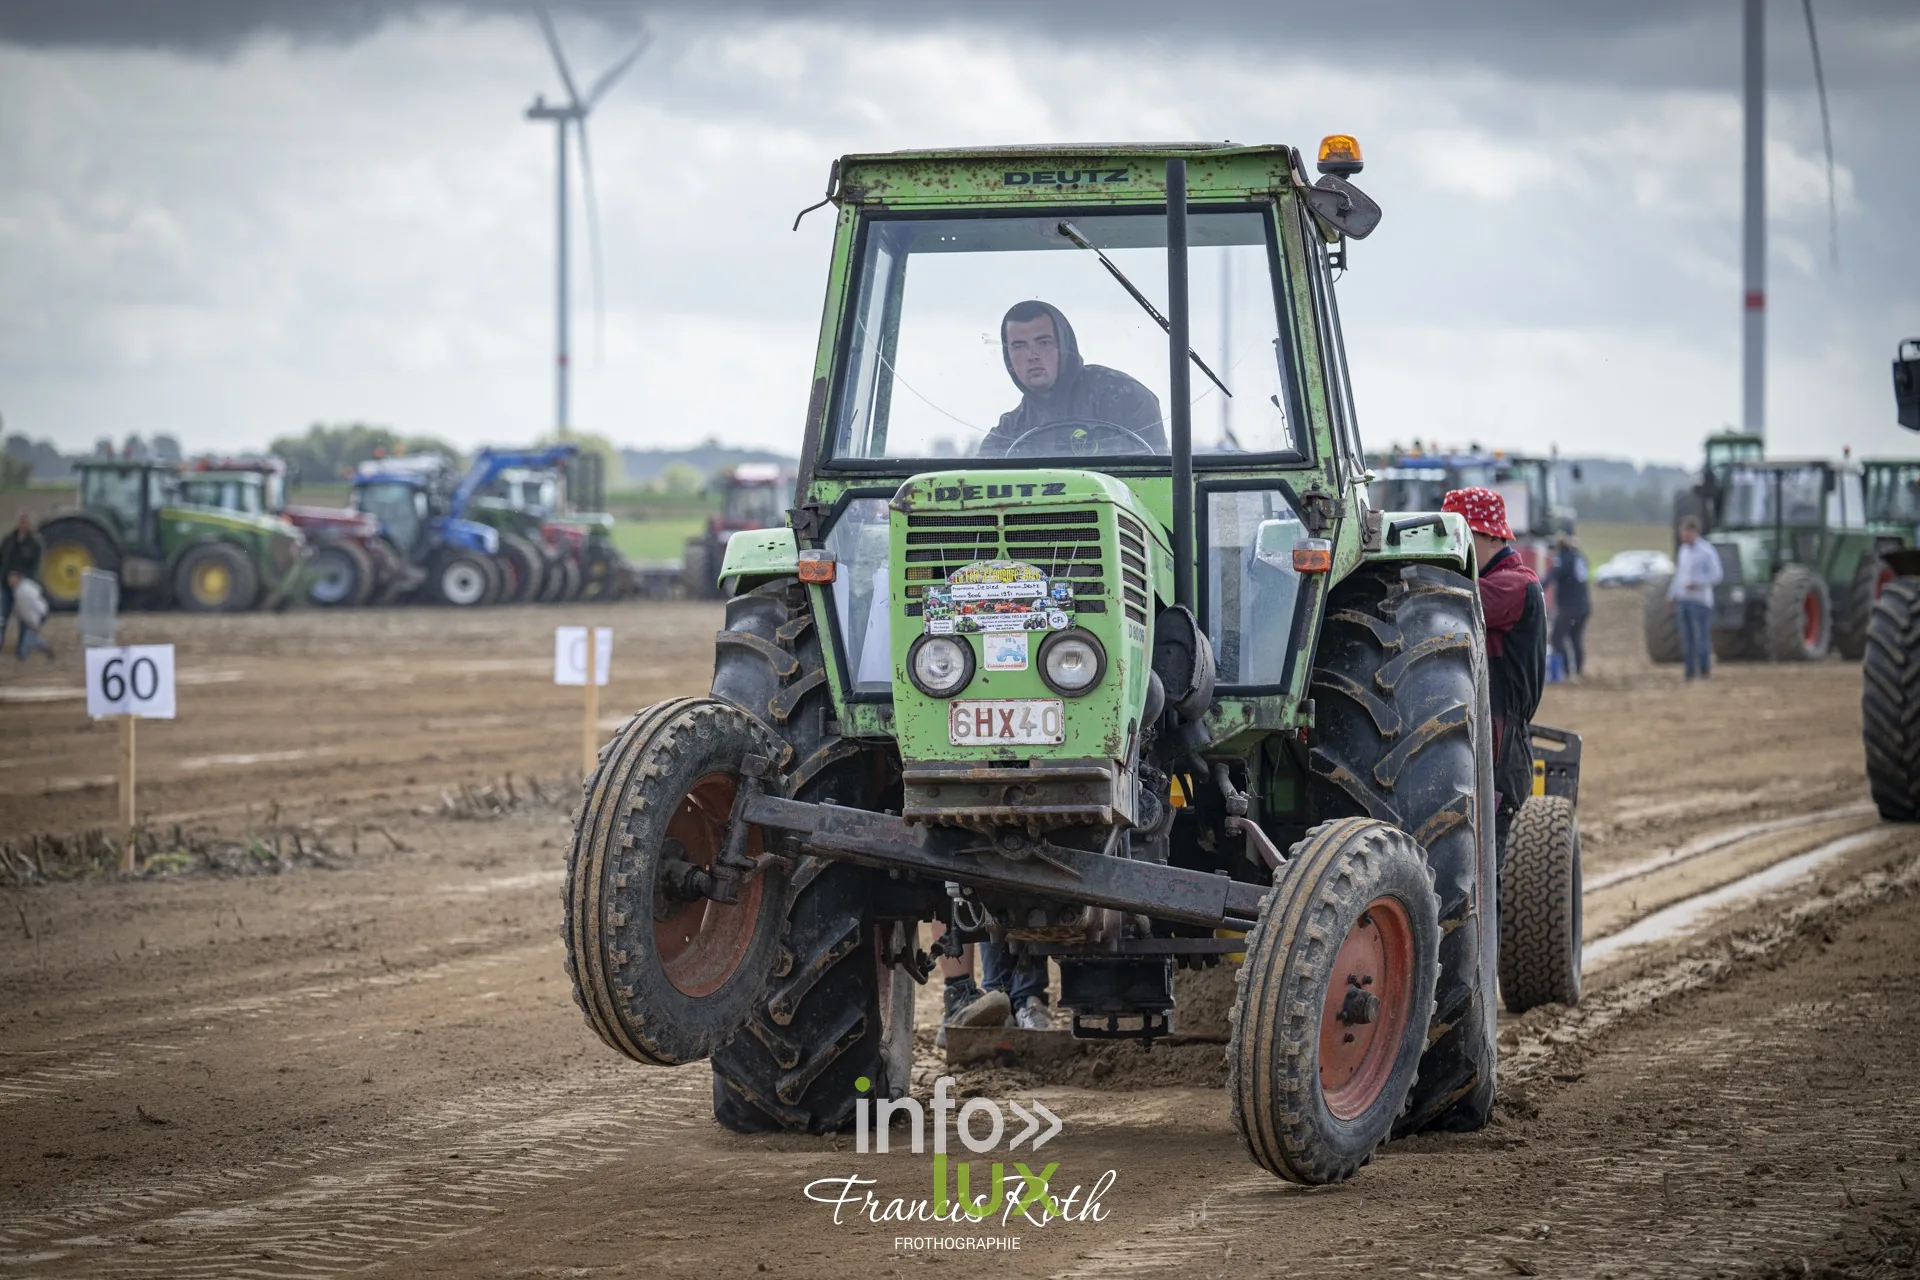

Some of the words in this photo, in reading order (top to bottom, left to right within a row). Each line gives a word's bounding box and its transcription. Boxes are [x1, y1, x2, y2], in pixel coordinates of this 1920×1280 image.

[1004, 169, 1129, 186] DEUTZ
[934, 483, 1067, 502] DEUTZ
[102, 656, 159, 702] 60
[953, 706, 1060, 738] 6HX40
